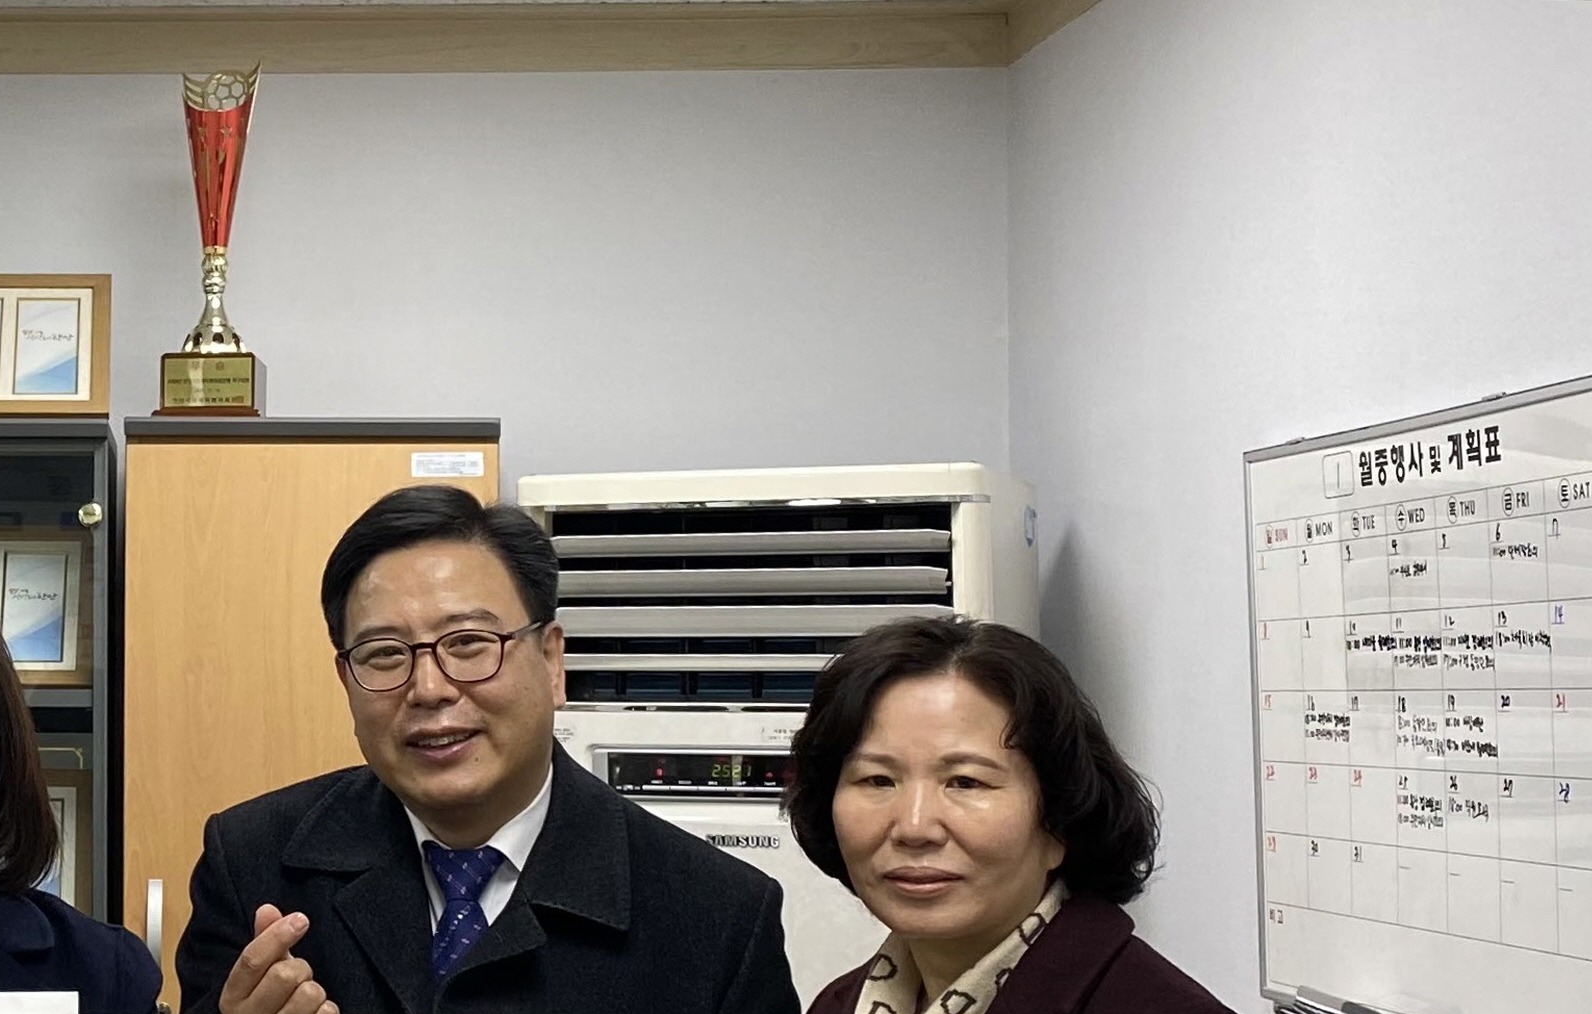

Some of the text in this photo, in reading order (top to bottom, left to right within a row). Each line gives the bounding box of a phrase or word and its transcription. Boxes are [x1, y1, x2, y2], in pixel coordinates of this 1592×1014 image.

[1359, 425, 1502, 487] 월중행사 및 계획표
[1516, 491, 1530, 508] FRI
[1573, 482, 1591, 500] SAT
[1408, 507, 1425, 524] WED
[1459, 500, 1476, 517] THU
[1315, 522, 1333, 537] MON
[1362, 515, 1376, 530] TUE
[1274, 528, 1289, 542] SUN
